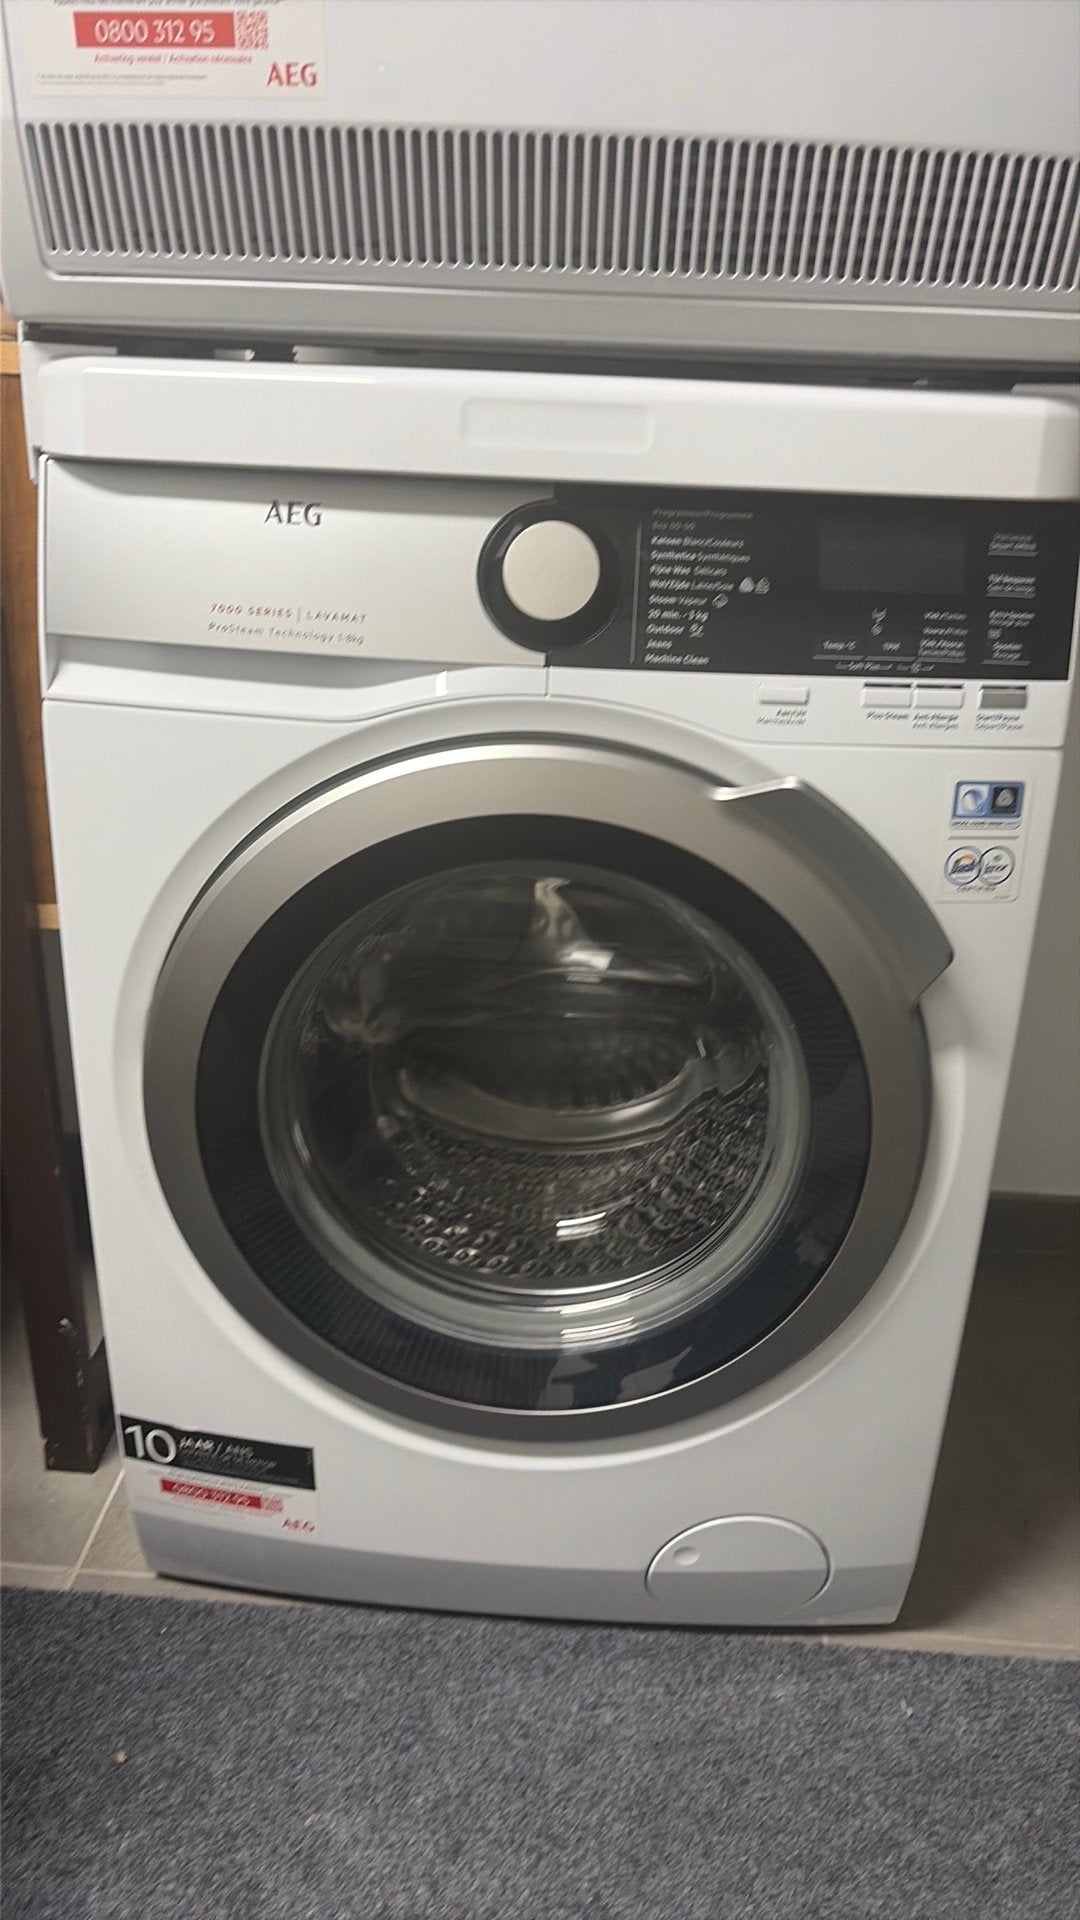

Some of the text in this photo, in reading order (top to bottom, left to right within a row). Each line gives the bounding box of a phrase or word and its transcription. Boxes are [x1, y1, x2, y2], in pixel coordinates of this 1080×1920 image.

[95, 19, 215, 43] 0800 312 95
[267, 62, 318, 88] AEG
[264, 500, 322, 526] AEG
[210, 602, 367, 623] 7000 SERIES LAVAMAT
[648, 608, 661, 619] 20
[696, 610, 709, 623] kg
[268, 626, 334, 643] Technology
[646, 624, 685, 635] Outdoor
[646, 638, 673, 649] Jeans
[644, 652, 710, 665] Machine Clean
[124, 1424, 177, 1464] 10
